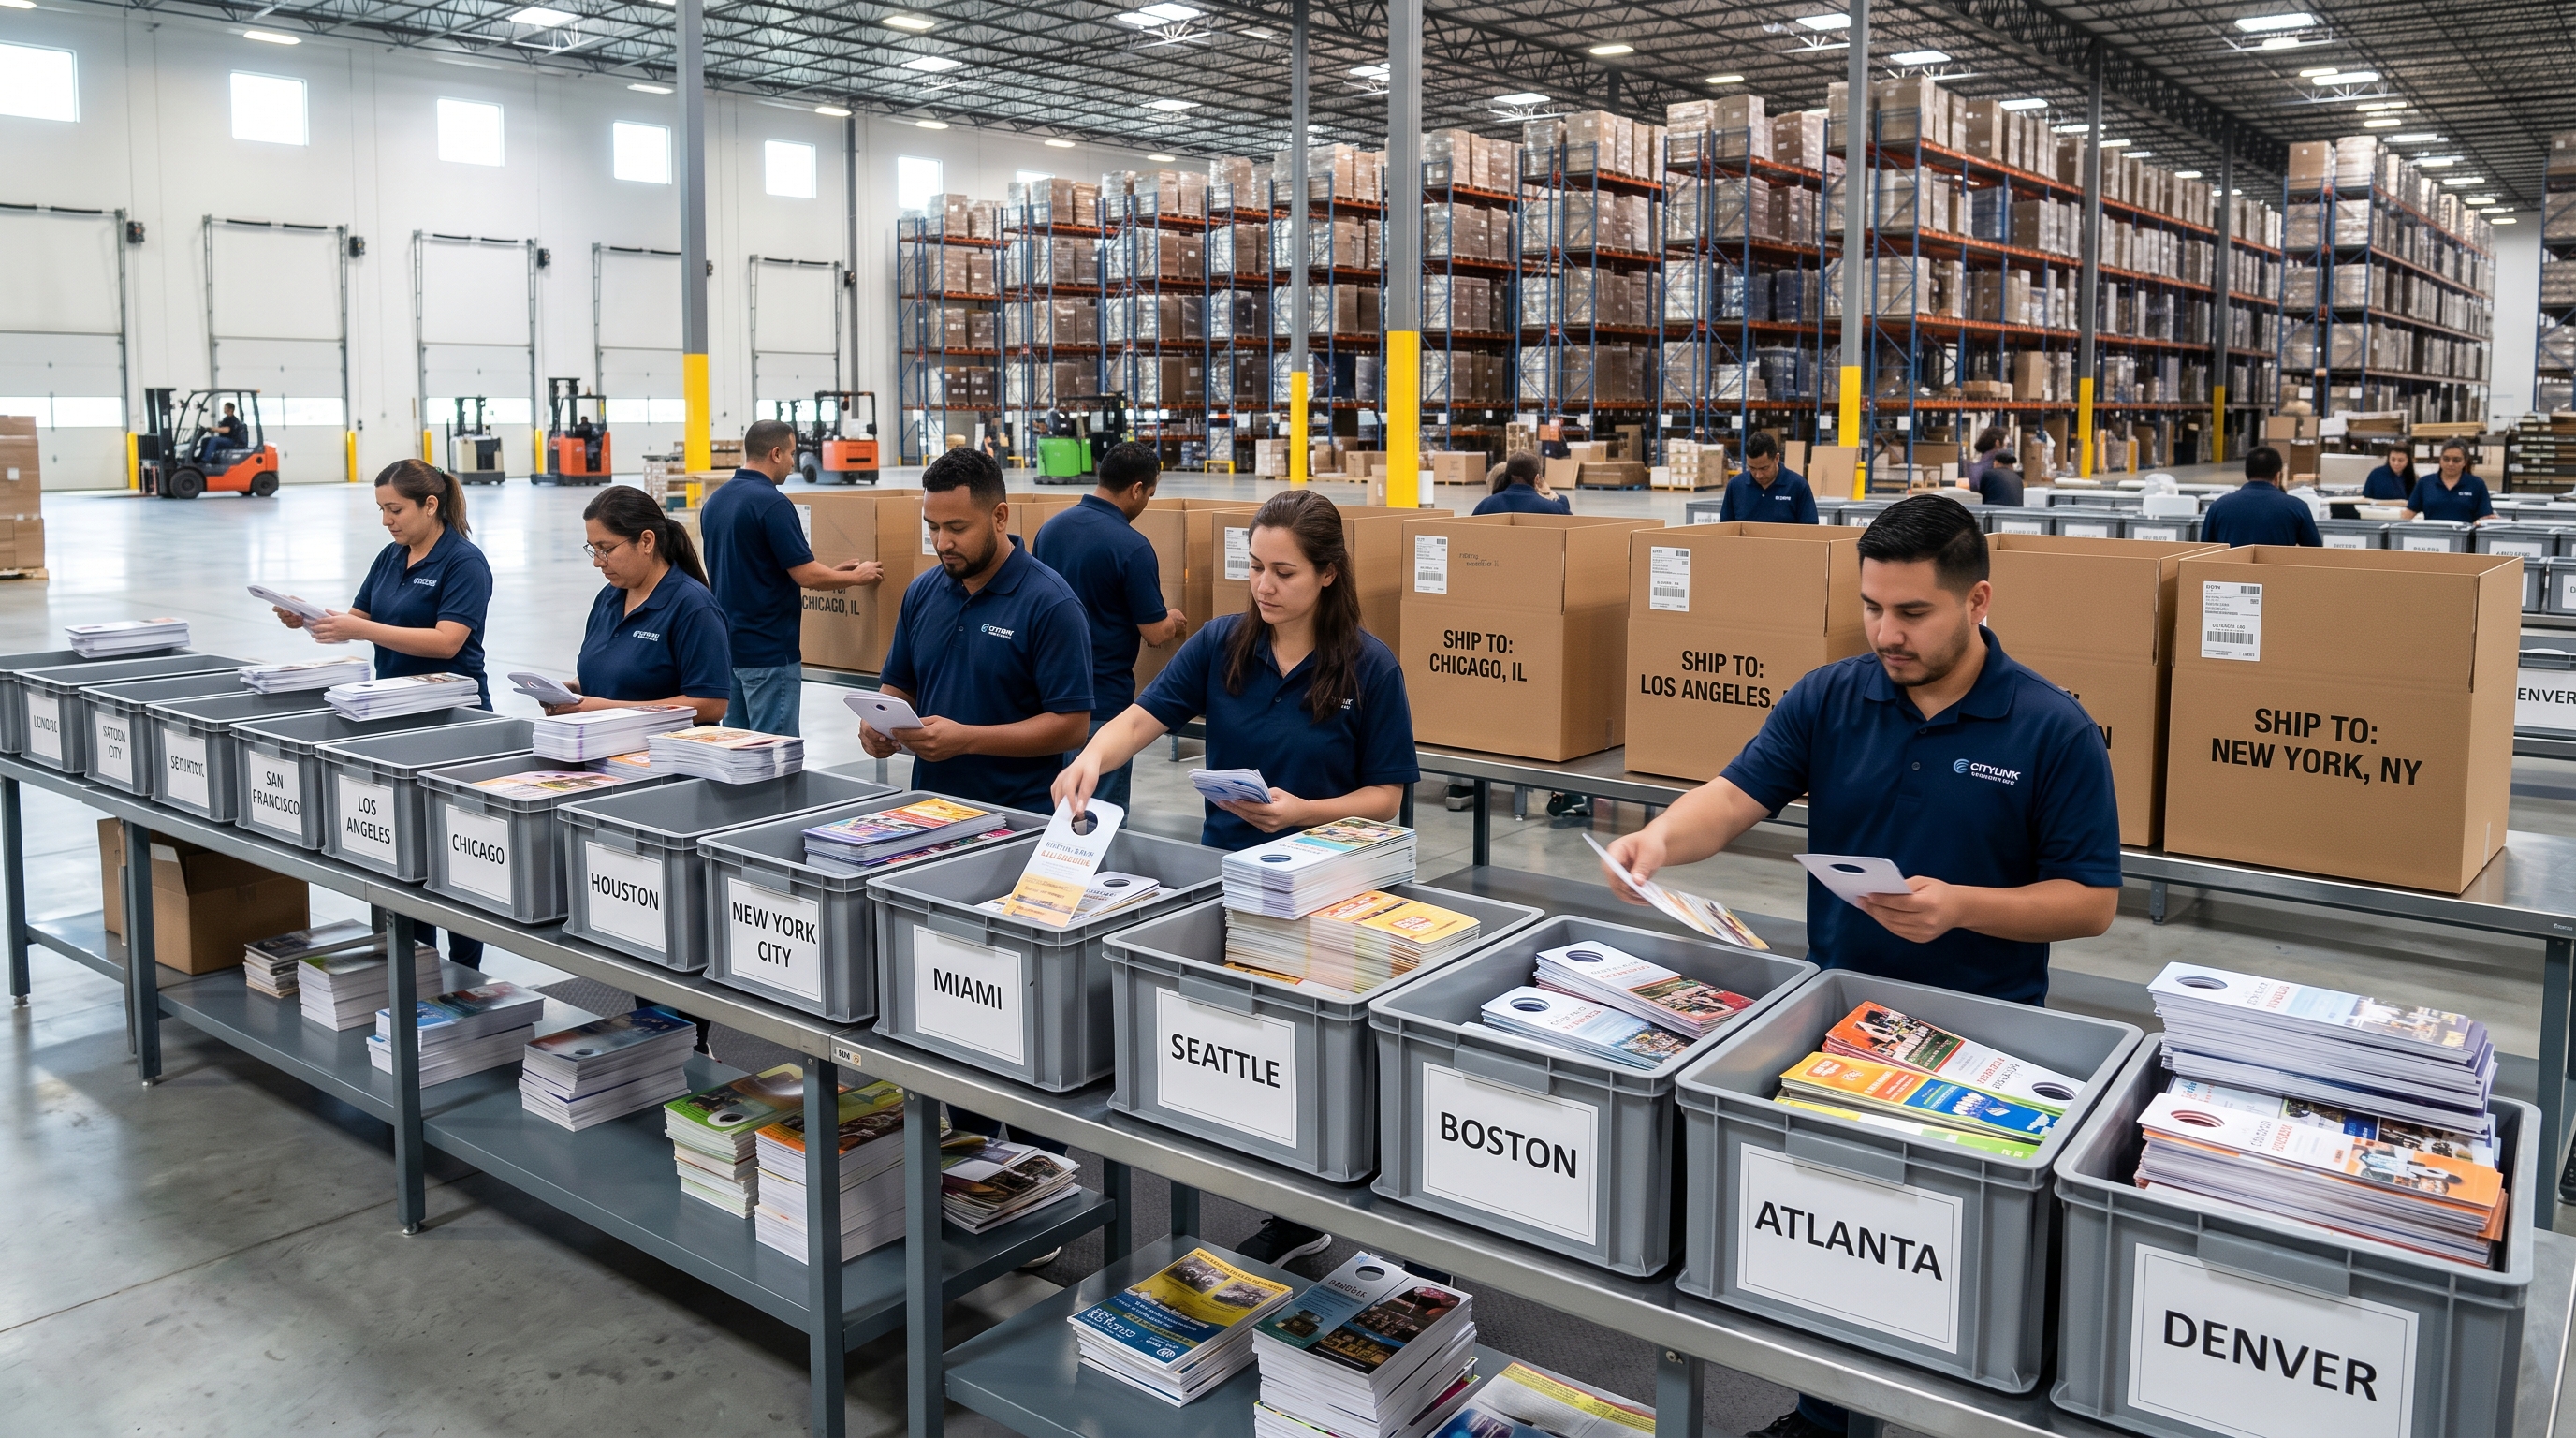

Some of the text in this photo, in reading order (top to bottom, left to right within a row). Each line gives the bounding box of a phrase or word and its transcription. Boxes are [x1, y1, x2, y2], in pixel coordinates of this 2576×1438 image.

[802, 595, 860, 617] CHICAGO, IL
[1443, 629, 1513, 653] SHIP TO:
[1430, 653, 1527, 683] CHICAGO, IL
[1682, 651, 1764, 678] SHIP TO:
[1641, 674, 1676, 697] LOS
[2255, 709, 2378, 744] SHIP TO:
[1970, 763, 2021, 780] CITYLINK
[2212, 738, 2422, 785] NEW YORK, NY
[266, 770, 284, 790] SAN
[253, 789, 300, 815] FRANCISCO
[358, 796, 376, 815] LOS
[346, 817, 390, 844] ANGELES
[452, 834, 505, 865] CHICAGO
[591, 873, 659, 910] HOUSTON
[733, 902, 816, 944] NEW YORK
[757, 940, 792, 968] CITY
[933, 967, 1003, 1010] MIAMI
[1171, 1033, 1281, 1089] SEATTLE
[1441, 1111, 1576, 1179] BOSTON
[1754, 1200, 1943, 1282] ATLANTA
[2163, 1309, 2378, 1402] DENVER
